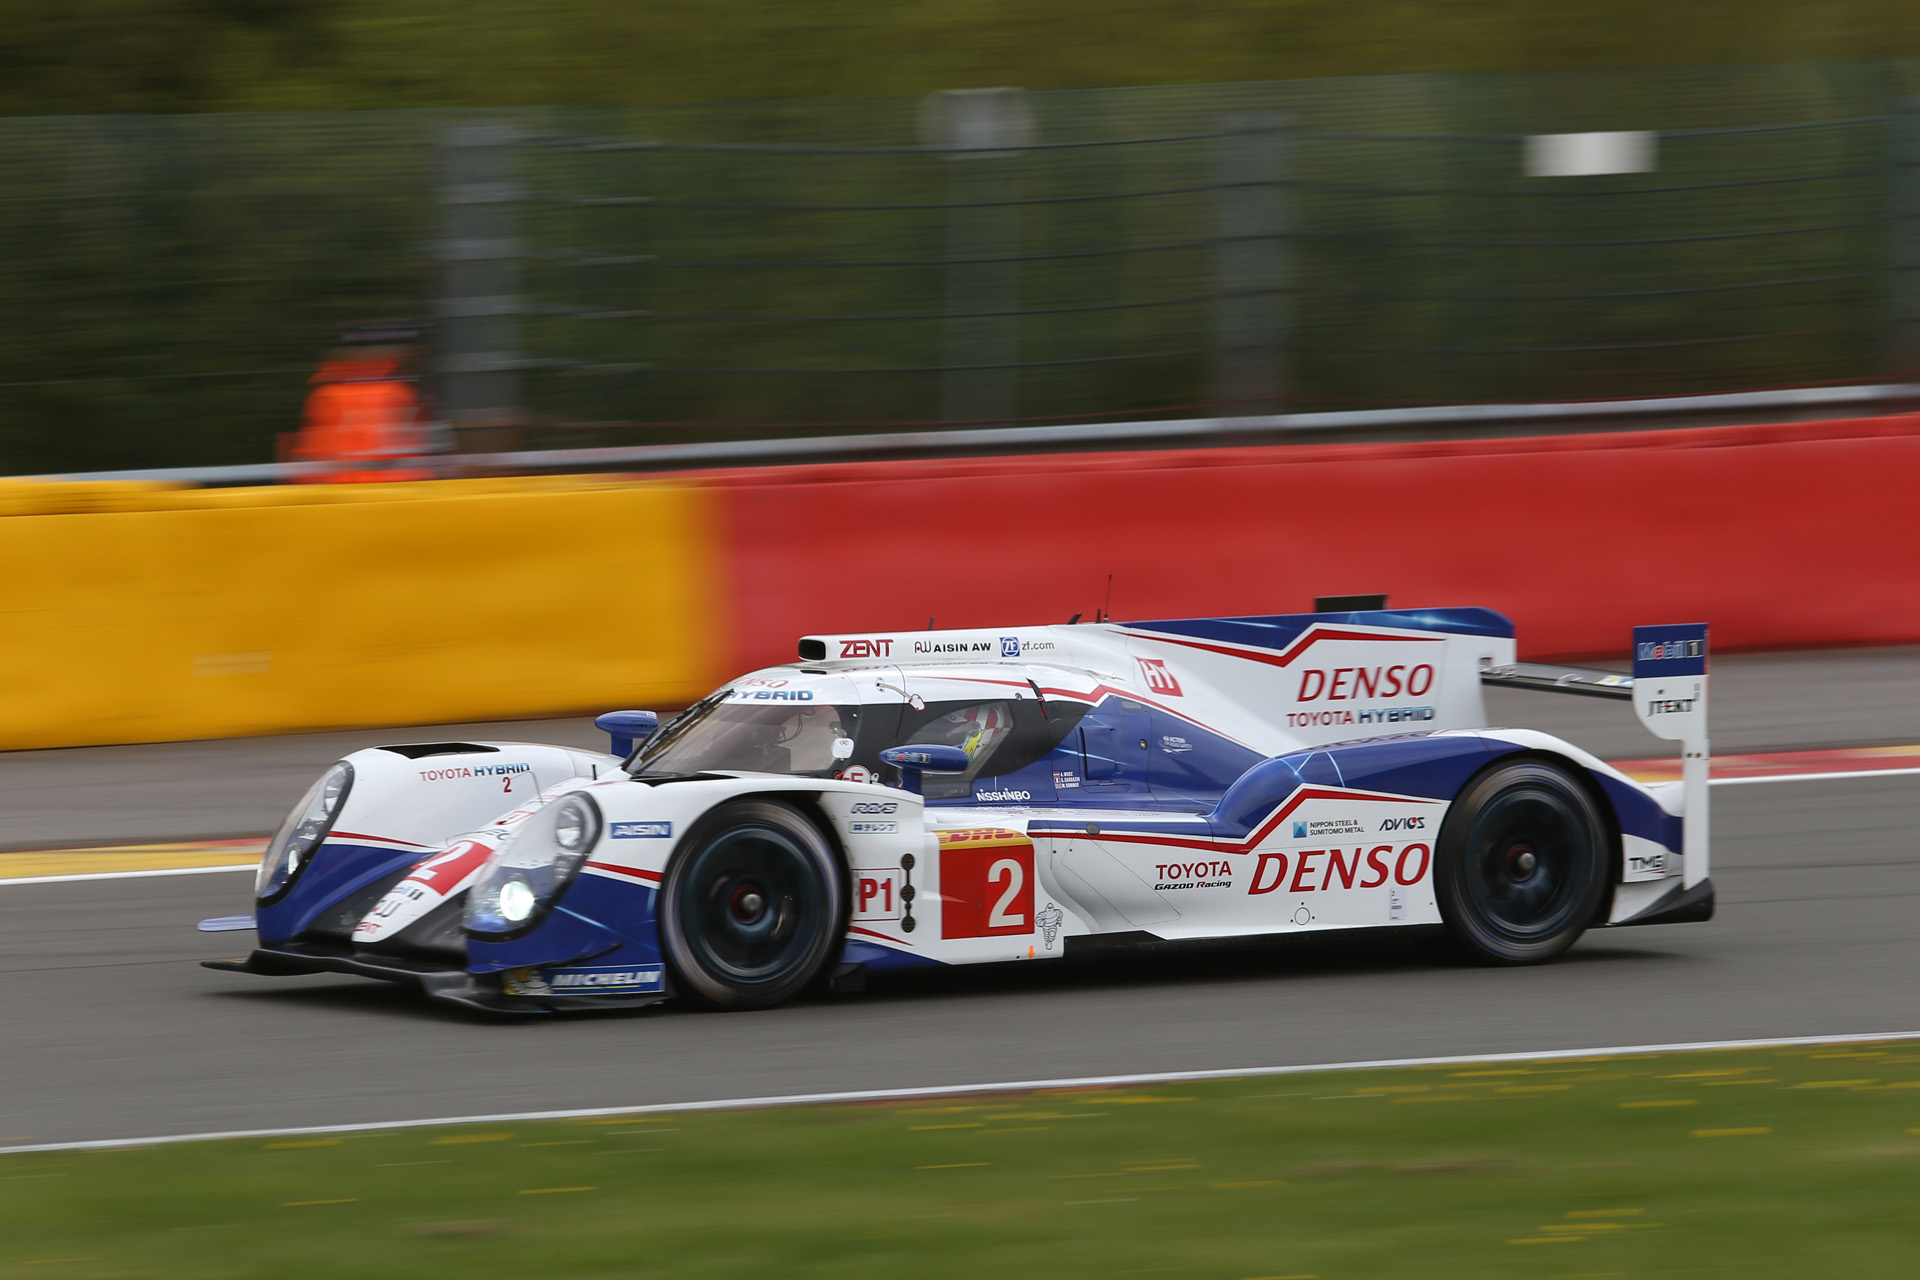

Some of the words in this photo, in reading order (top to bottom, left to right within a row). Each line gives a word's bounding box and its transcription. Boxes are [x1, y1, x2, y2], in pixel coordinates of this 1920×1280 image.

[839, 639, 894, 658] ZENT
[934, 644, 968, 653] AISIN
[972, 643, 991, 652] AW
[1022, 641, 1055, 650] zf.com
[1638, 641, 1685, 660] Mobil
[1296, 664, 1433, 702] DENSO
[1286, 710, 1355, 728] TOYOTA
[1358, 706, 1435, 724] HYBRID
[419, 768, 471, 781] TOYOTA
[474, 763, 530, 776] HYBRID
[502, 776, 512, 793] 2
[850, 803, 898, 813] RAYS
[947, 828, 1014, 842] DHL
[1310, 828, 1343, 836] SUMITOMO
[1156, 861, 1232, 879] TOYOTA
[1248, 843, 1430, 895] DENSO
[988, 858, 1025, 928] 2
[1196, 880, 1232, 888] Racing
[859, 878, 892, 912] P1
[552, 971, 661, 986] MICHELIN
